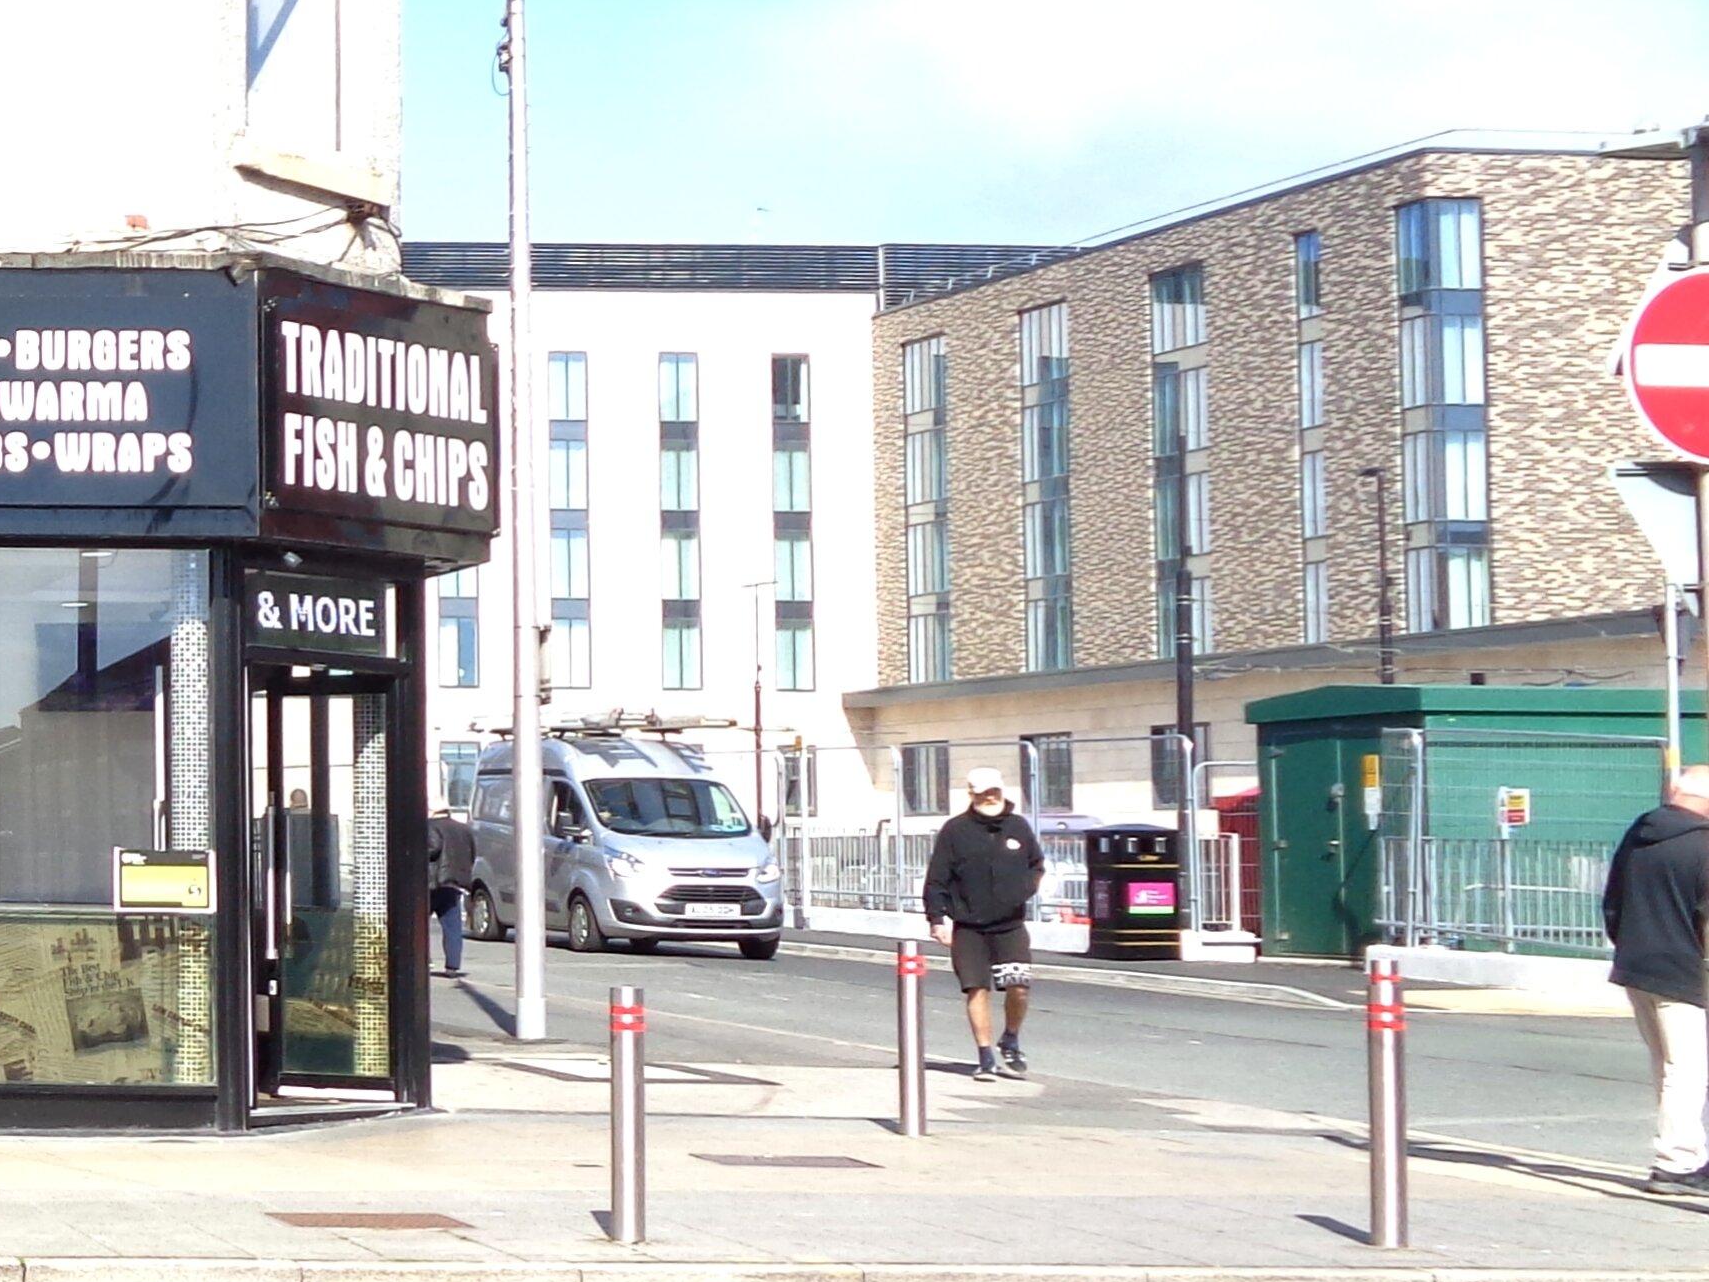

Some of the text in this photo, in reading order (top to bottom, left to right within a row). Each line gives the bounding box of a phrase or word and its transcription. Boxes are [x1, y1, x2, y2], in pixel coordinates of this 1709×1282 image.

[281, 320, 488, 424] TRADITIONAL
[284, 412, 489, 511] FISH & CHIPS
[257, 590, 376, 637] & MORE
